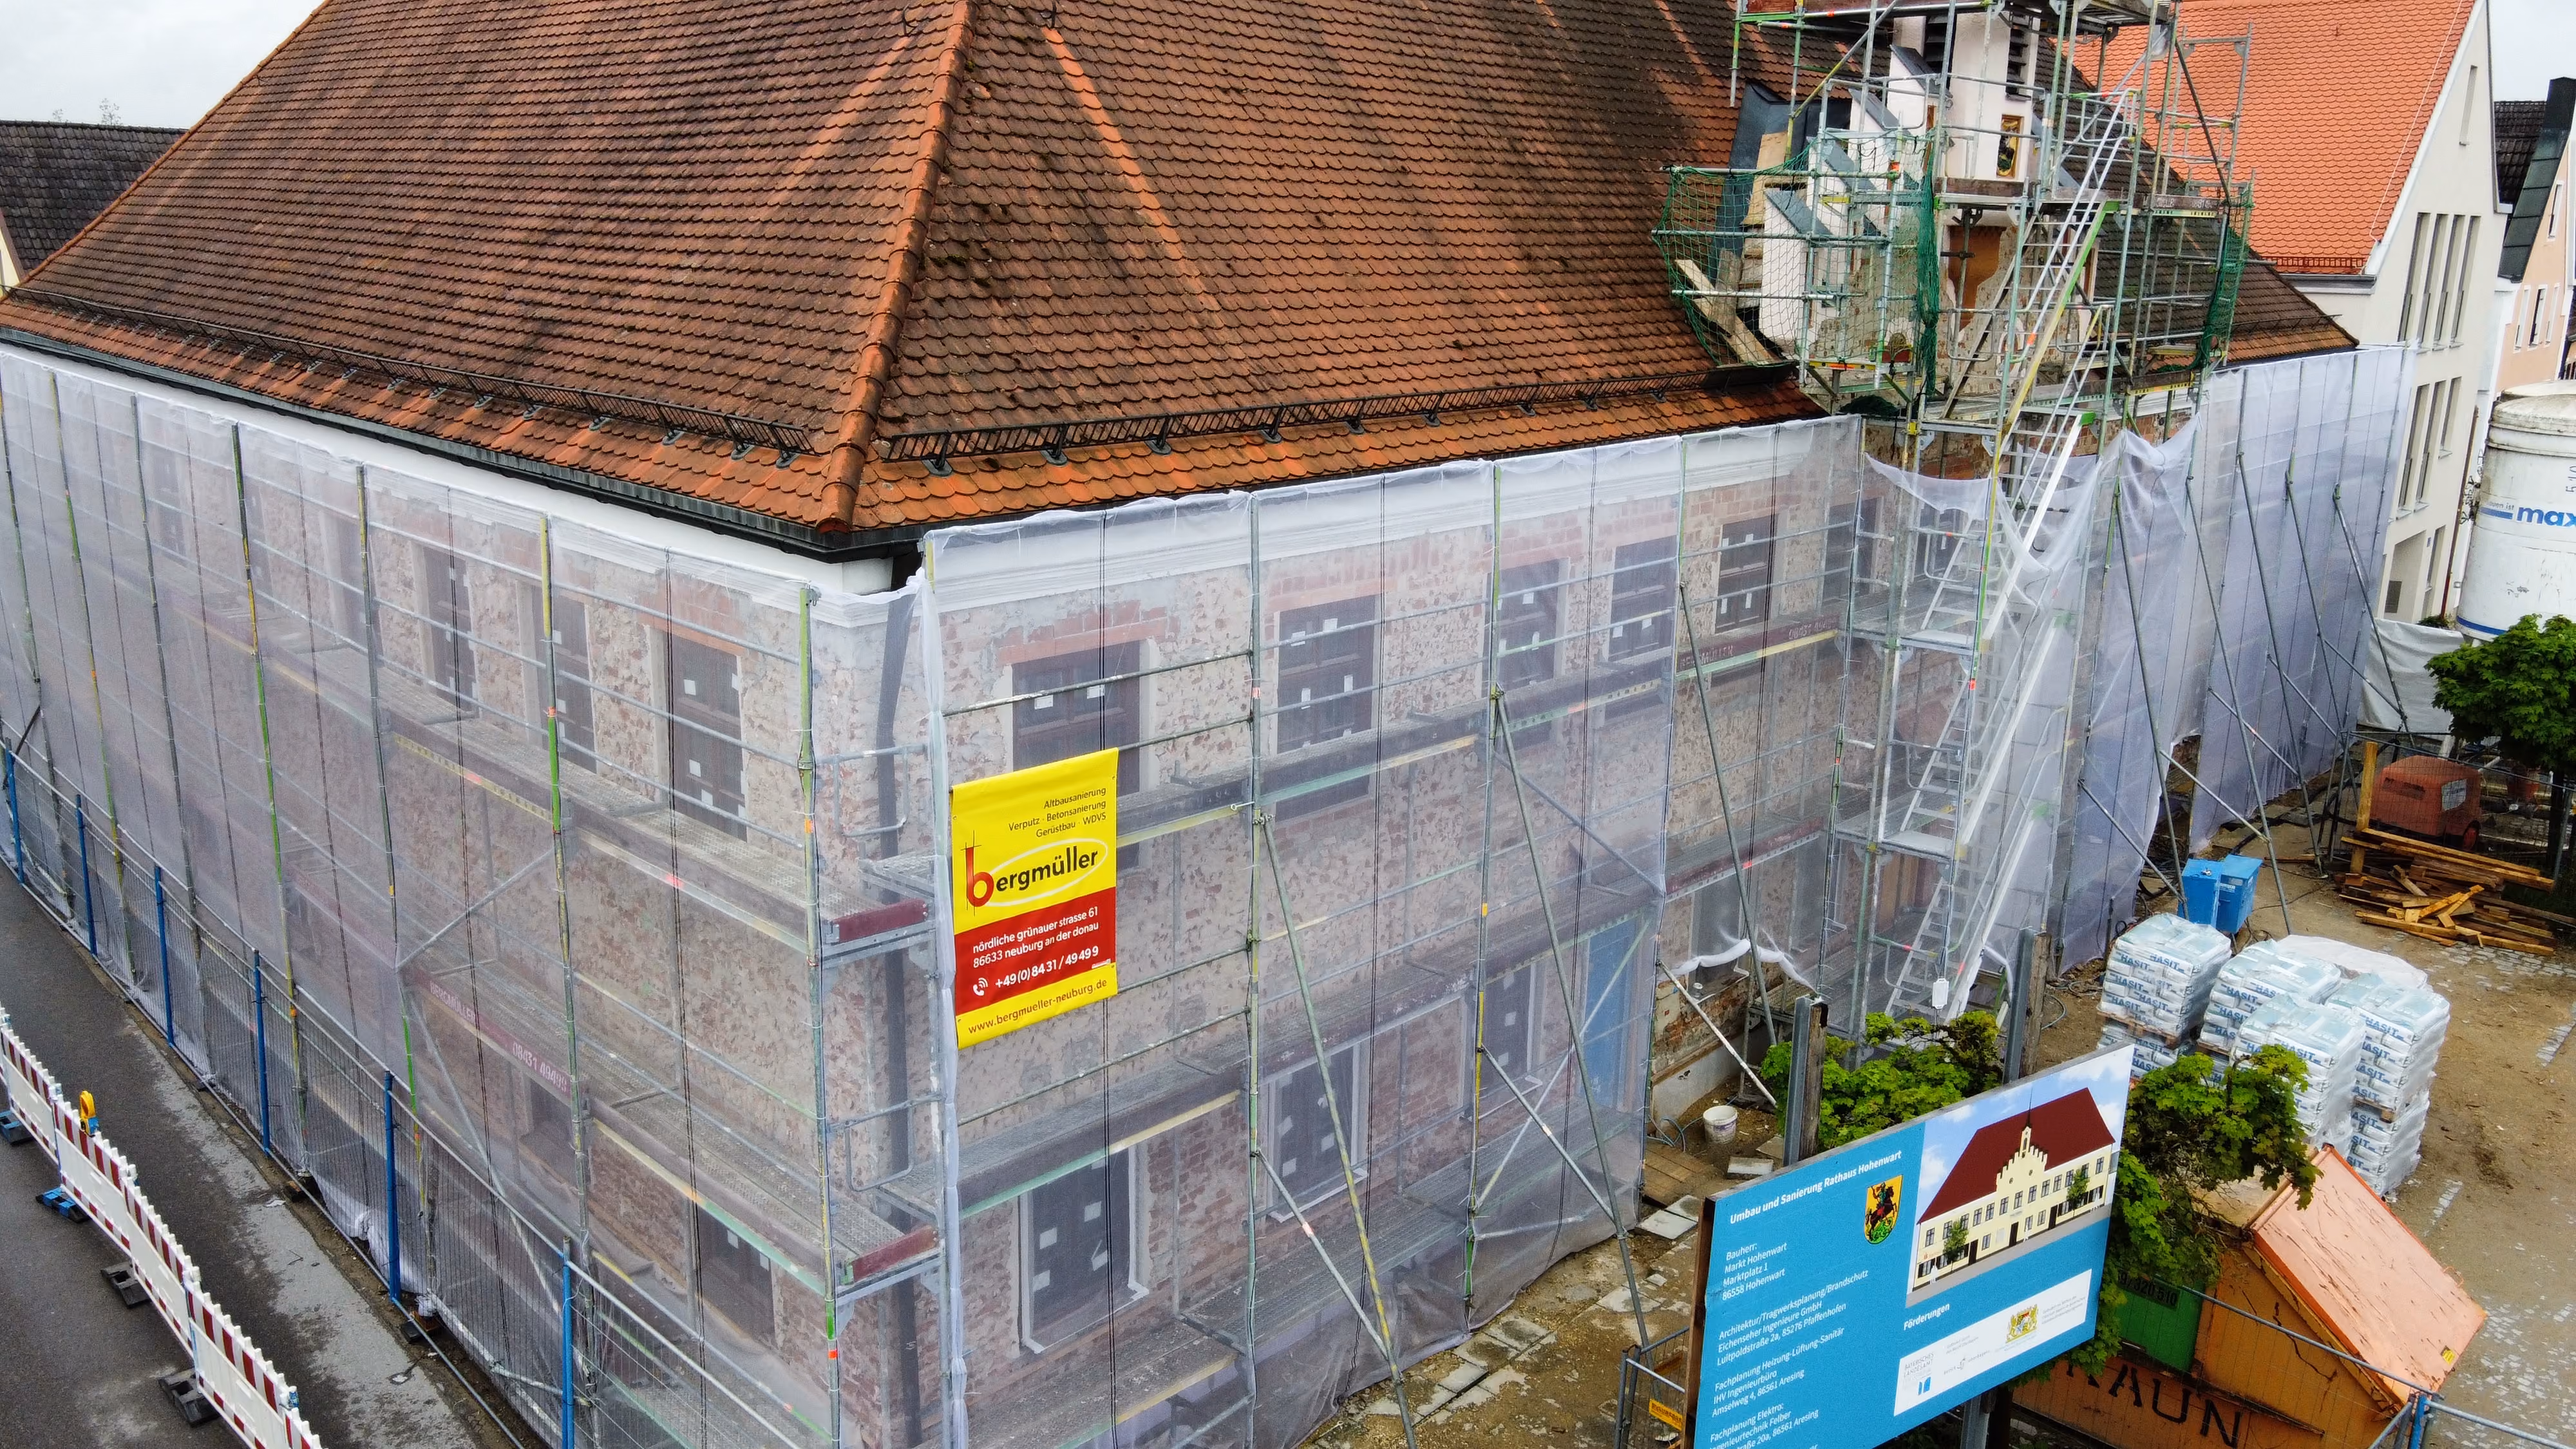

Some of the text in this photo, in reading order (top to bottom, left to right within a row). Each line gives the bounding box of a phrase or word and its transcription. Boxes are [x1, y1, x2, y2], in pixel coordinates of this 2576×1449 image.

[1043, 786, 1106, 810] Altbausanierung
[1009, 800, 1106, 832] Verputz Betonsanierung
[1036, 812, 1106, 838] Gerüstbau WDVS
[965, 846, 1098, 907] bergmüller
[973, 906, 1098, 953] nördliche grünauer strasse 61
[973, 922, 1099, 968] 86633 neuburg an der donau
[2121, 954, 2150, 970] HASIT
[2116, 974, 2144, 990] HASIT
[2227, 987, 2258, 1003] HASIT
[2256, 985, 2277, 998] HAS
[968, 979, 1107, 1034] www.bergmueller-neuburg.de
[2112, 996, 2141, 1011] HASIT
[2139, 993, 2168, 1010] HASIT
[2215, 1026, 2236, 1039] HAS
[2365, 1018, 2400, 1037] HASIT
[513, 1042, 538, 1070] 08431
[2132, 1058, 2157, 1071] HASI
[2352, 1086, 2380, 1100] ASIT
[2352, 1112, 2378, 1127] ASIT
[2351, 1135, 2370, 1149] SIT
[2347, 1156, 2363, 1168] SIT
[1730, 1150, 1902, 1224] Umbau und Sanierung Rathaus Hohenwart
[1725, 1242, 1787, 1274] Markt Hohenwart
[1726, 1243, 1757, 1261] Bauherr:
[1721, 1268, 1786, 1301] 86558 Hohenwart
[1723, 1262, 1768, 1287] Marktplatz 1
[1719, 1269, 1869, 1340] Architektur/Tragwerksplanung/Brandschutz
[1904, 1303, 1950, 1331] Förderungen
[1717, 1303, 1846, 1366] Luitpoldstraße 2a, 85276 Pfaffenhofen
[1718, 1301, 1823, 1353] Eichenseher Ingenieure GmbH
[1714, 1327, 1844, 1392] Fachplanung Heizung-Lüftung-Sanitär
[1712, 1369, 1805, 1417] Amselweg 4, 86561 Aresing
[1714, 1370, 1777, 1405] IHV Ingenieurbüro
[1710, 1403, 1784, 1443] Fachplanung Elektro:
[1710, 1410, 1792, 1449] genieurtechnik Felber
[1756, 1434, 1772, 1444] 20a,
[1772, 1421, 1793, 1437] 86561
[1794, 1409, 1819, 1428] Aresing
